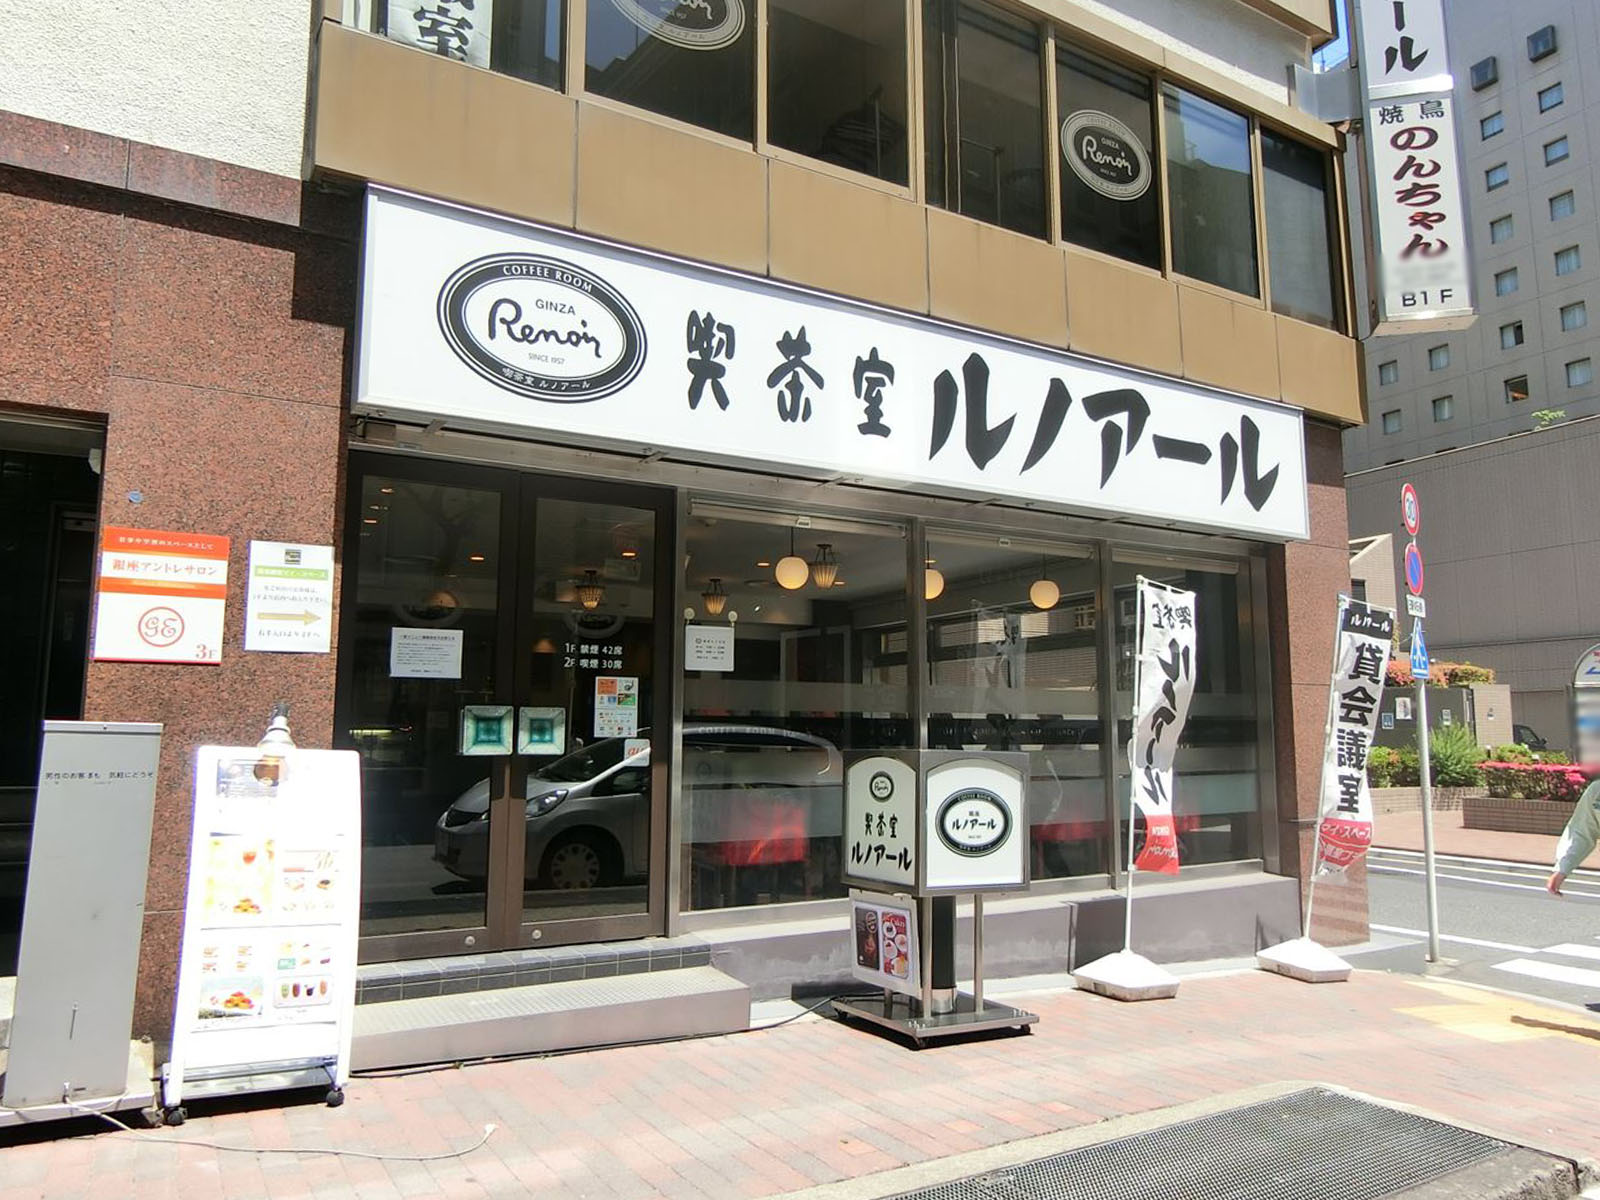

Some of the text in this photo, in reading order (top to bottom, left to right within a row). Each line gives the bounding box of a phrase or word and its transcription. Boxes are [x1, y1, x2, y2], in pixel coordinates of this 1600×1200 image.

[414, 0, 475, 63] 室
[1379, 101, 1444, 125] 焼鳥
[1389, 126, 1449, 261] のんちゃん
[503, 264, 593, 293] COFFEE ROOM
[535, 299, 576, 316] GINZA
[686, 309, 1281, 512] 喫茶室 ルノアール
[112, 558, 217, 576] 銀座アントレサロン
[195, 643, 218, 660] 3F
[565, 643, 577, 653] 1F
[563, 657, 576, 668] 2F
[1337, 642, 1383, 814] 貸会議室
[952, 818, 997, 831] ルノアール
[851, 841, 913, 872] ルノアール
